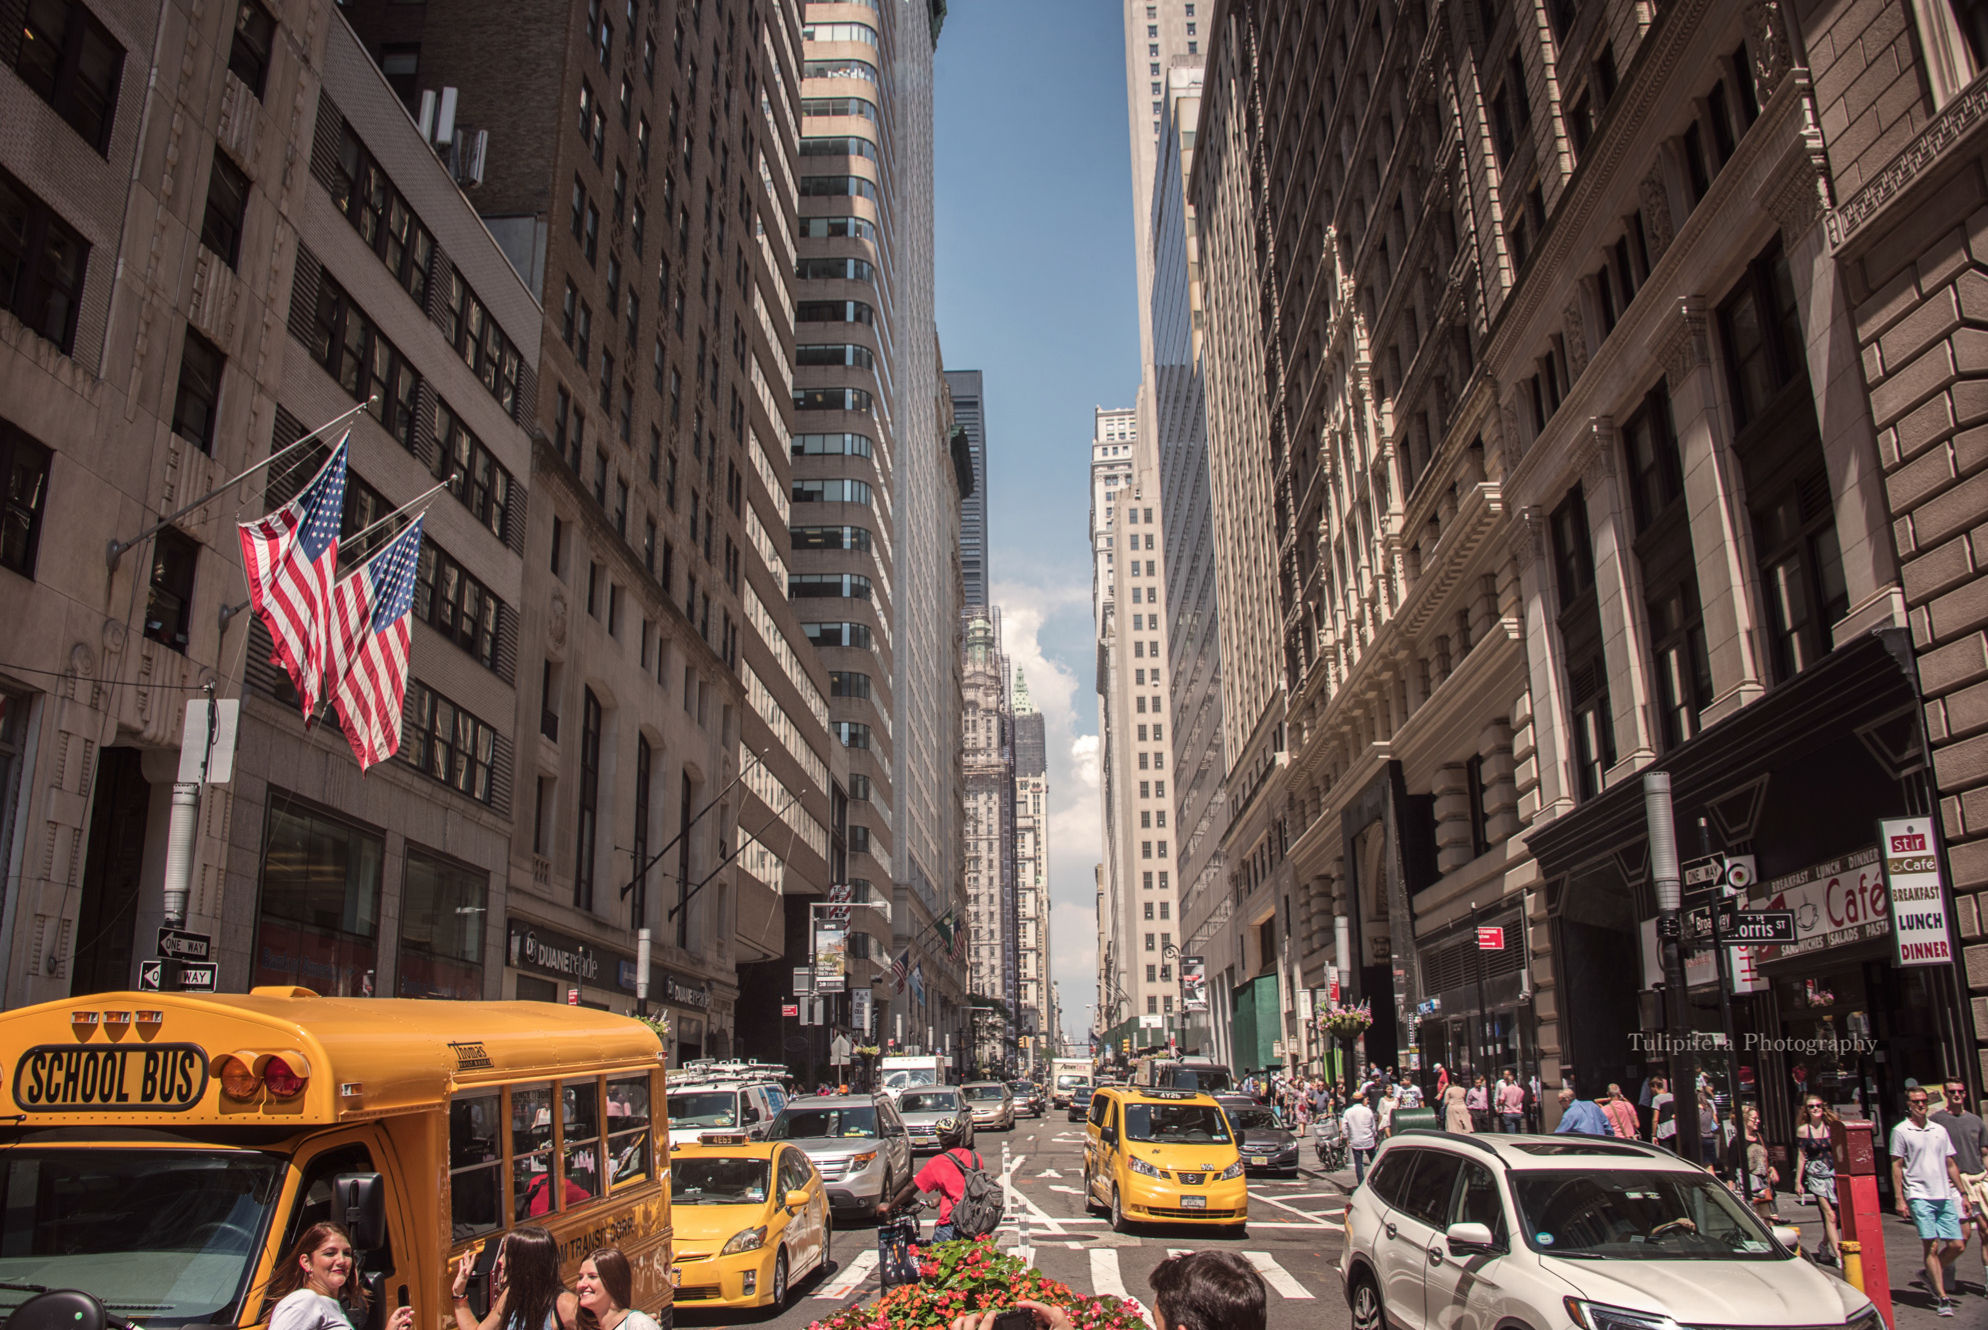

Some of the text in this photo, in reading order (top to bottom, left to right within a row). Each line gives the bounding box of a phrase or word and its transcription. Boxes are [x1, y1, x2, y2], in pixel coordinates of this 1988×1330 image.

[1687, 864, 1718, 883] ONE WAY
[1771, 848, 1880, 893] BREAKFAST LUNCH DINNER
[1903, 858, 1936, 871] Café
[1826, 871, 1887, 928] Café
[1892, 886, 1940, 902] BREAKFAST
[1695, 913, 1730, 932] Broaay
[1728, 920, 1774, 937] orris
[1776, 920, 1786, 929] ST
[1898, 913, 1943, 930] LUNCH
[166, 938, 204, 954] ONE WAY
[1781, 935, 1824, 956] SANDWICHES
[1829, 927, 1859, 945] SALADS
[1901, 941, 1949, 960] DINNER
[28, 1051, 195, 1103] SCHOOL BUS
[570, 1226, 607, 1260] TRANSIT
[611, 1217, 634, 1242] CORP.
